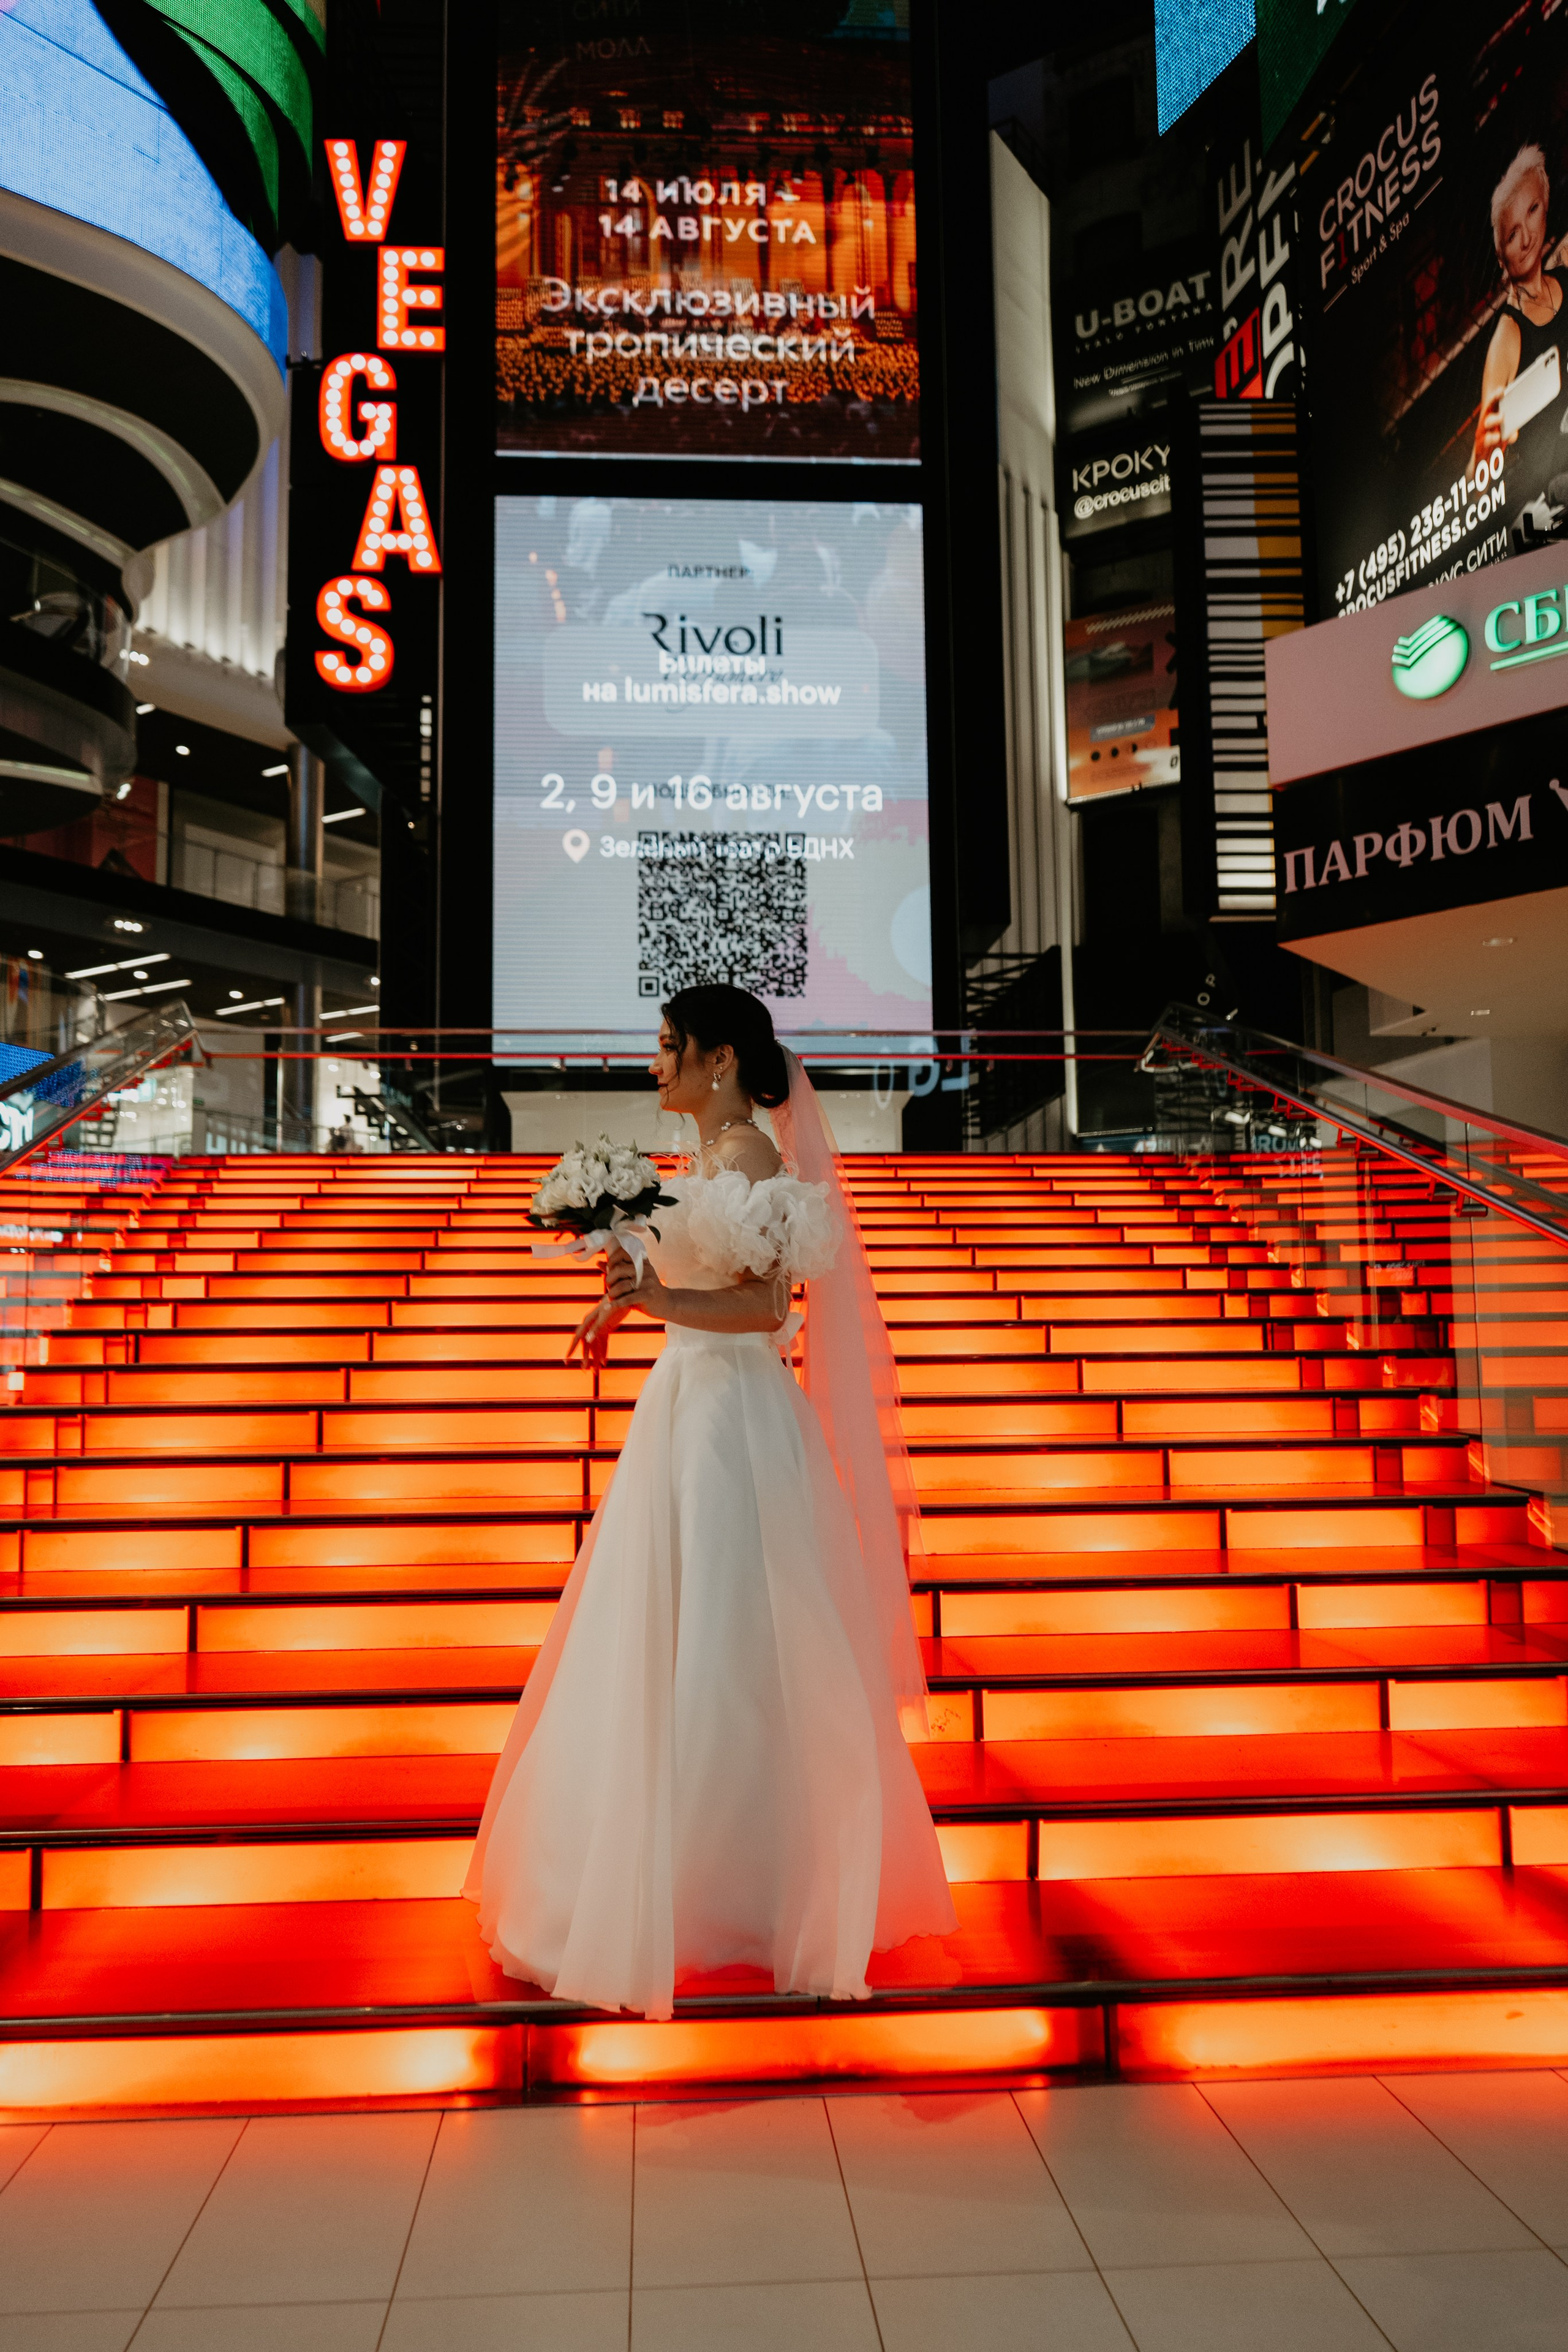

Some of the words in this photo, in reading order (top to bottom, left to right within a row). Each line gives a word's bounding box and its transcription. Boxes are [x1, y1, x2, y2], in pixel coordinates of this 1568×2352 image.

[1319, 72, 1439, 243] CROCUS
[605, 178, 642, 204] 14
[655, 179, 766, 206] ИЮЛЯ
[598, 214, 638, 239] 14
[648, 215, 817, 244] АВГУСТА
[542, 277, 875, 321] Эксклюзивный
[1074, 270, 1212, 339] U-BOAT
[562, 326, 856, 364] тропический
[315, 138, 446, 693] VEGAS
[632, 375, 791, 413] десерт
[1334, 568, 1355, 604] +7
[1358, 529, 1406, 591] (495)
[1409, 447, 1504, 548] 236-11-00
[1466, 526, 1507, 573] СИТИ
[642, 612, 783, 656] Rivoli
[1484, 584, 1568, 654] СБ
[582, 681, 617, 703] на
[625, 675, 842, 705] lumisfera.show
[539, 772, 576, 814] 2,
[590, 772, 617, 810] 9
[631, 782, 655, 810] и
[667, 774, 712, 811] 16
[725, 782, 884, 818] августа
[1284, 794, 1534, 895] ПАРФЮМ
